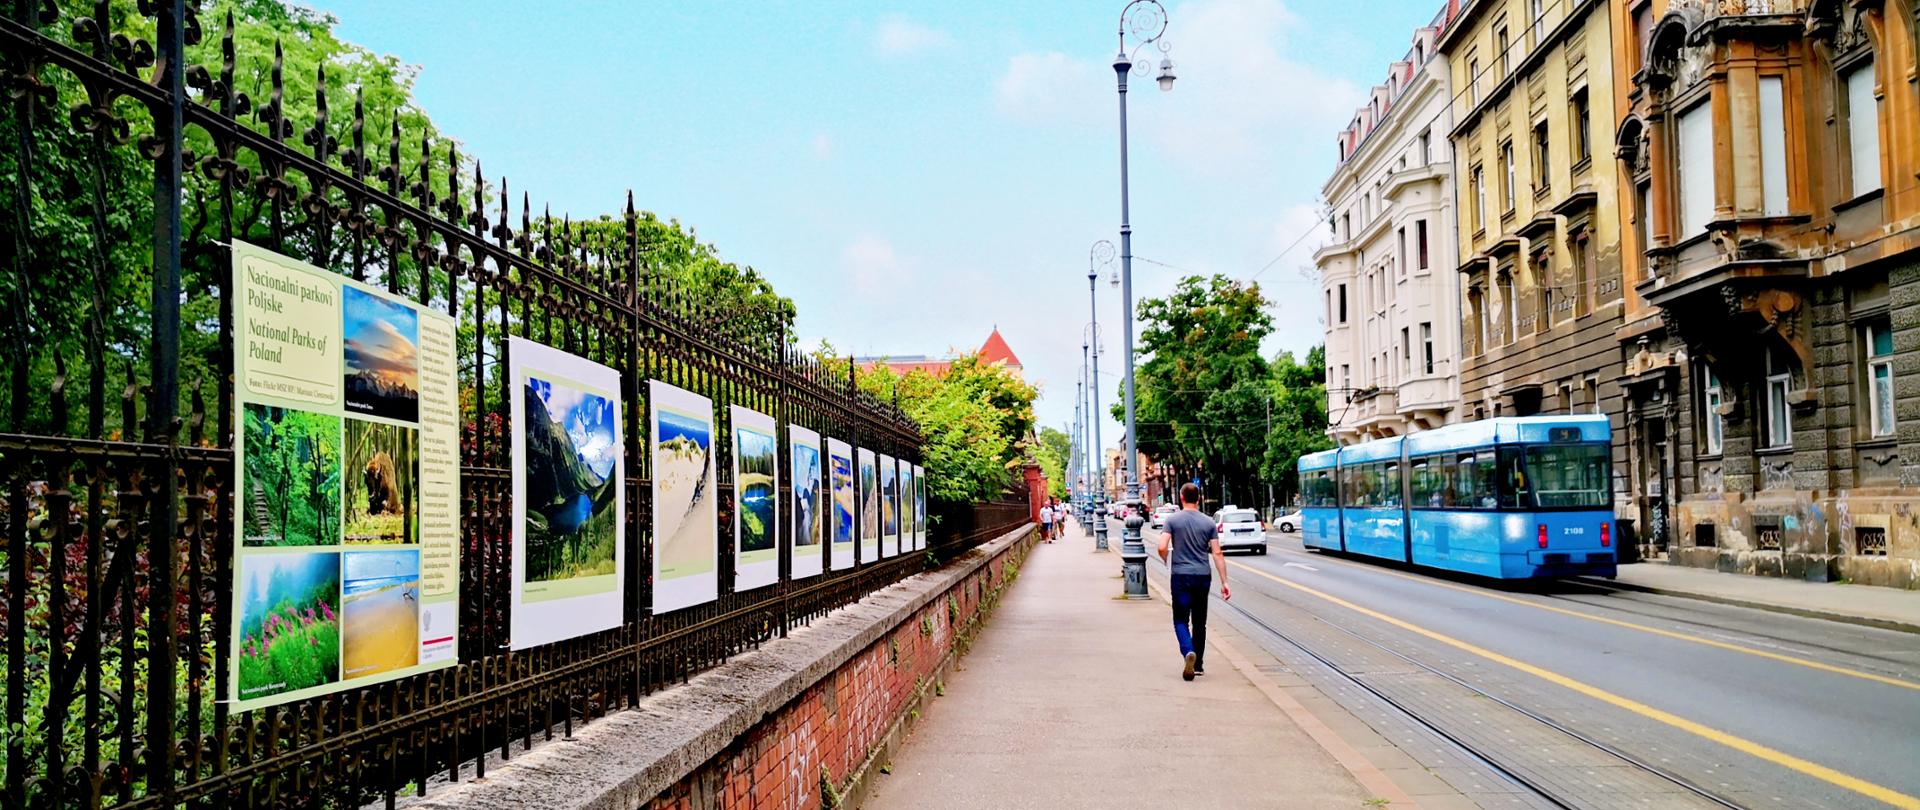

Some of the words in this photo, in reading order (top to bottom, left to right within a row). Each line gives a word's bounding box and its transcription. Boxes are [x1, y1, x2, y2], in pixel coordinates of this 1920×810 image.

[247, 264, 299, 296] Nacionalni
[300, 284, 333, 306] parkovi
[248, 287, 283, 314] Poljske
[248, 317, 290, 344] National
[291, 327, 316, 349] Parks
[317, 334, 328, 357] of
[249, 340, 282, 364] Poland
